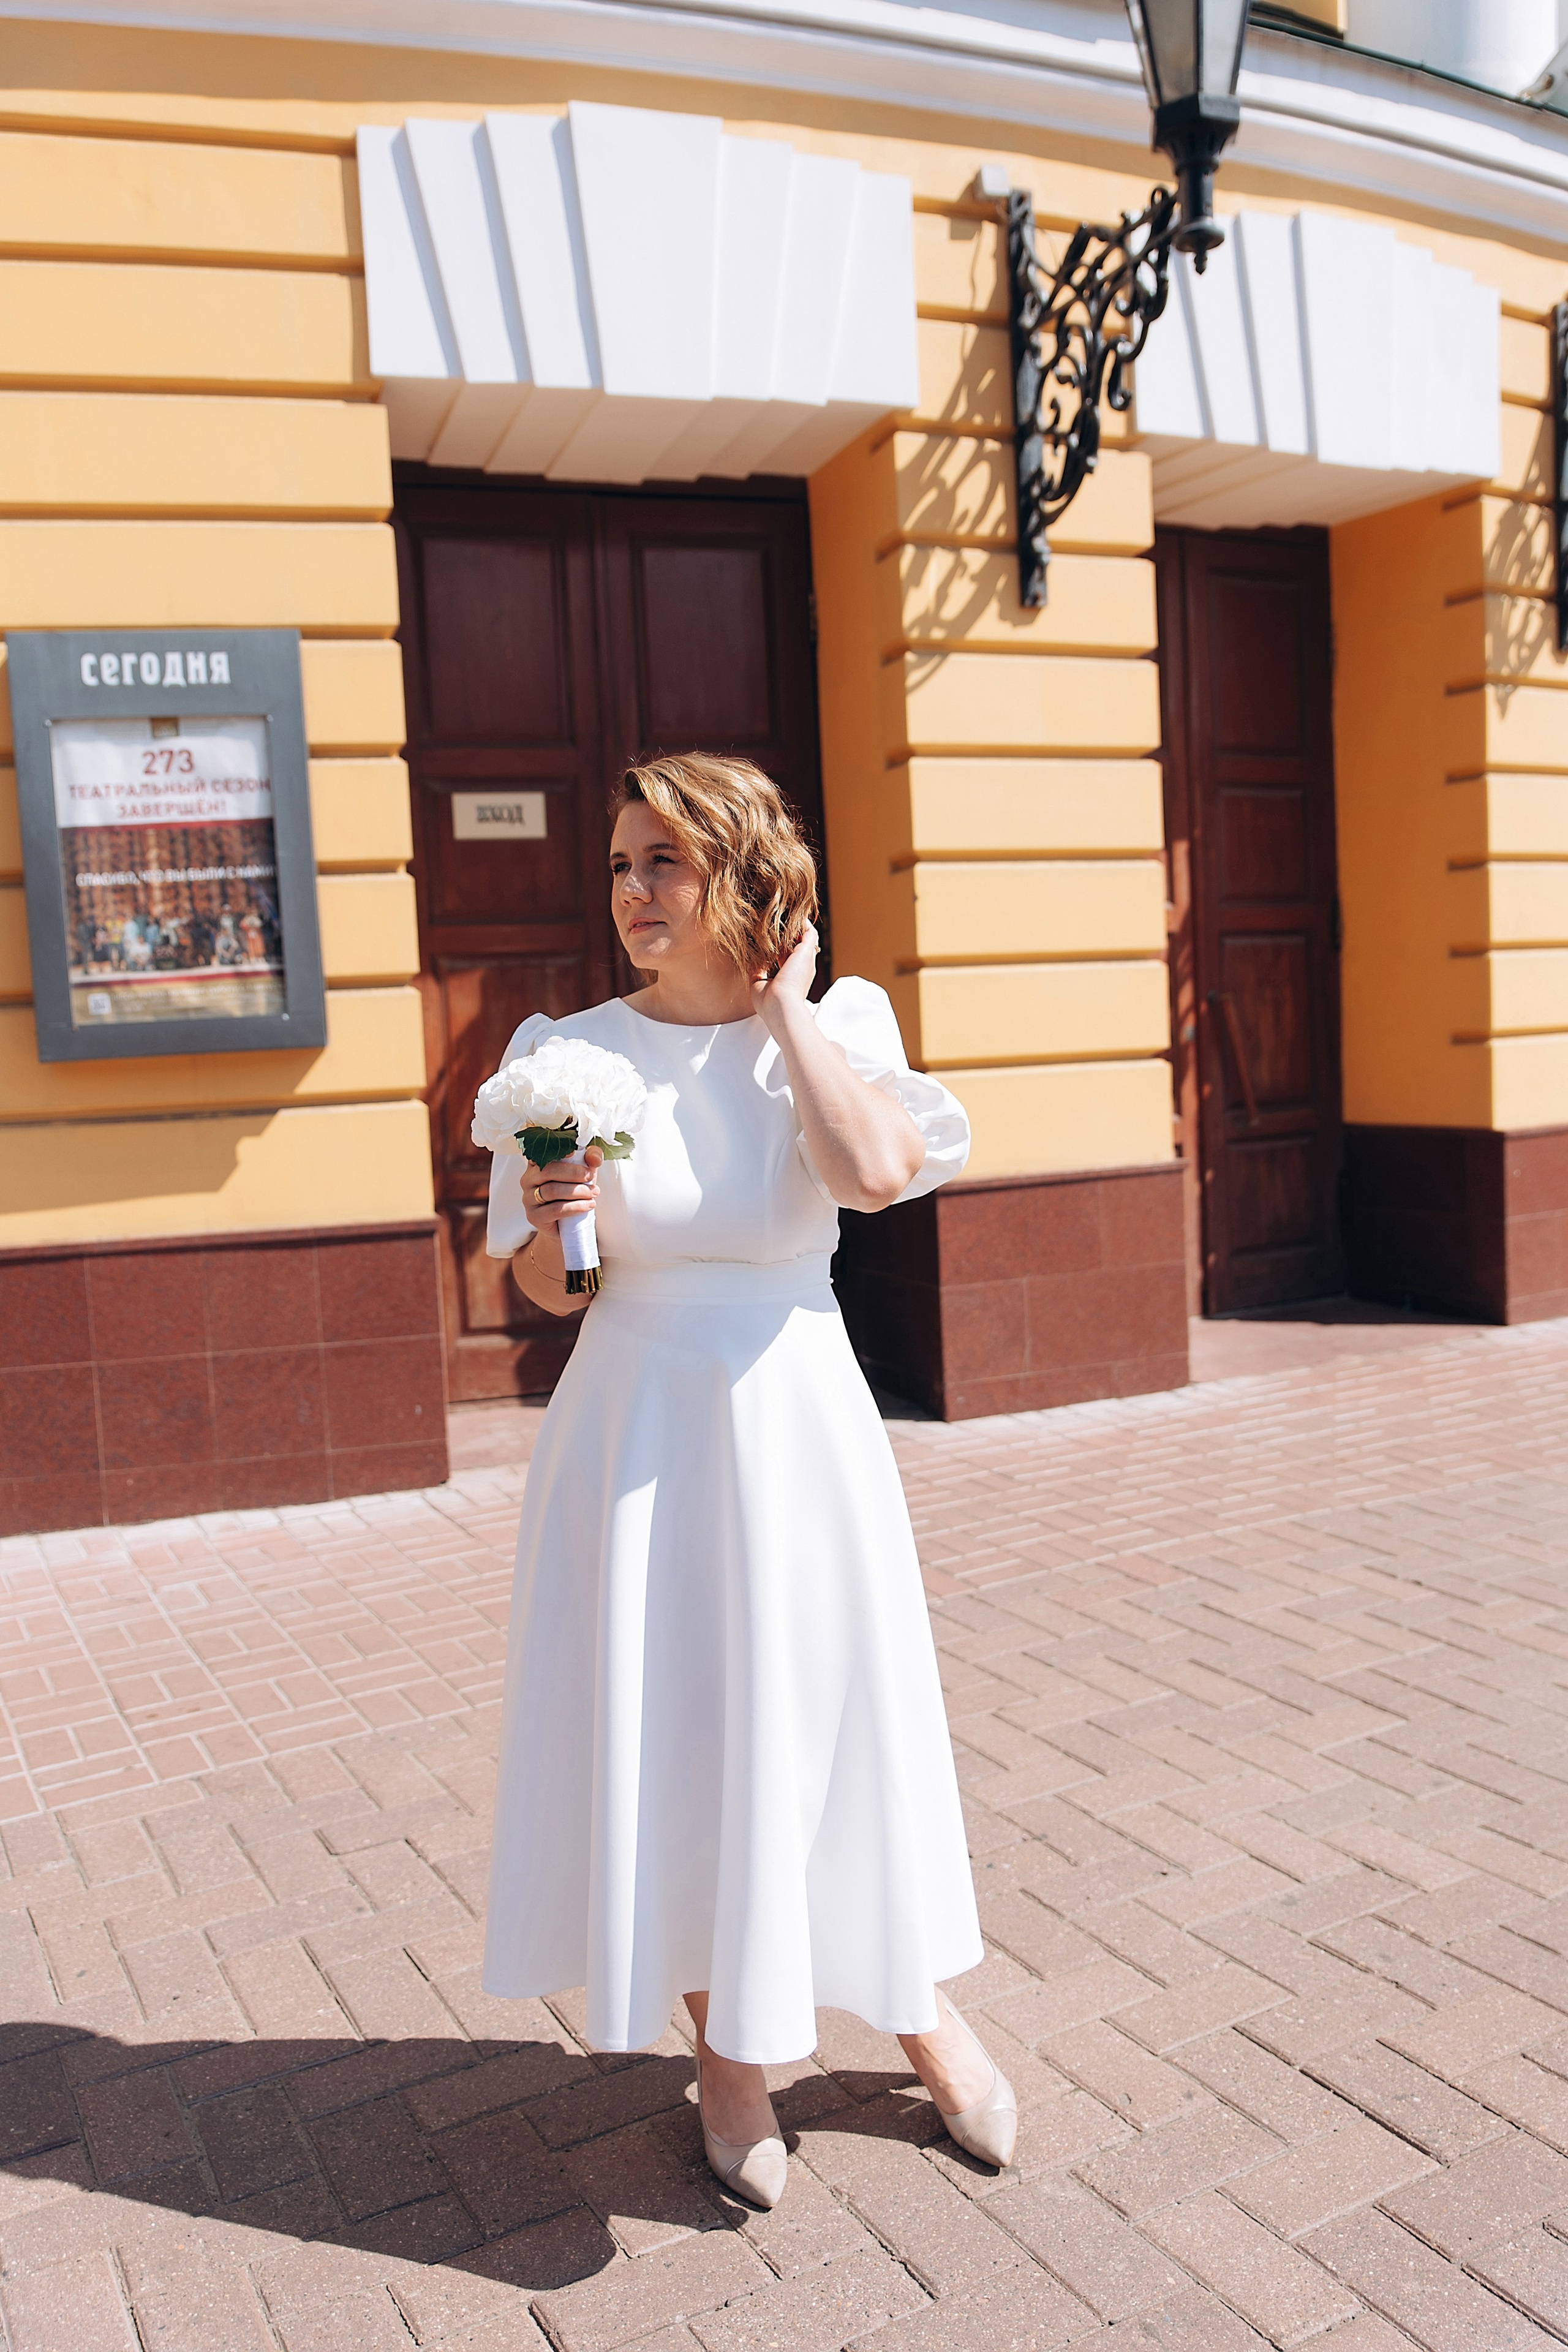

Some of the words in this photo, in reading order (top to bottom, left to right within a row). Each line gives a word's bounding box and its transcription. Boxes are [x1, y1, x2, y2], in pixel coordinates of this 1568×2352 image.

[80, 651, 231, 688] сегодня
[142, 749, 195, 775] 273
[69, 777, 206, 799] ТЕАТРАЛЬНЫЙ
[211, 778, 271, 794] СЕЗОН
